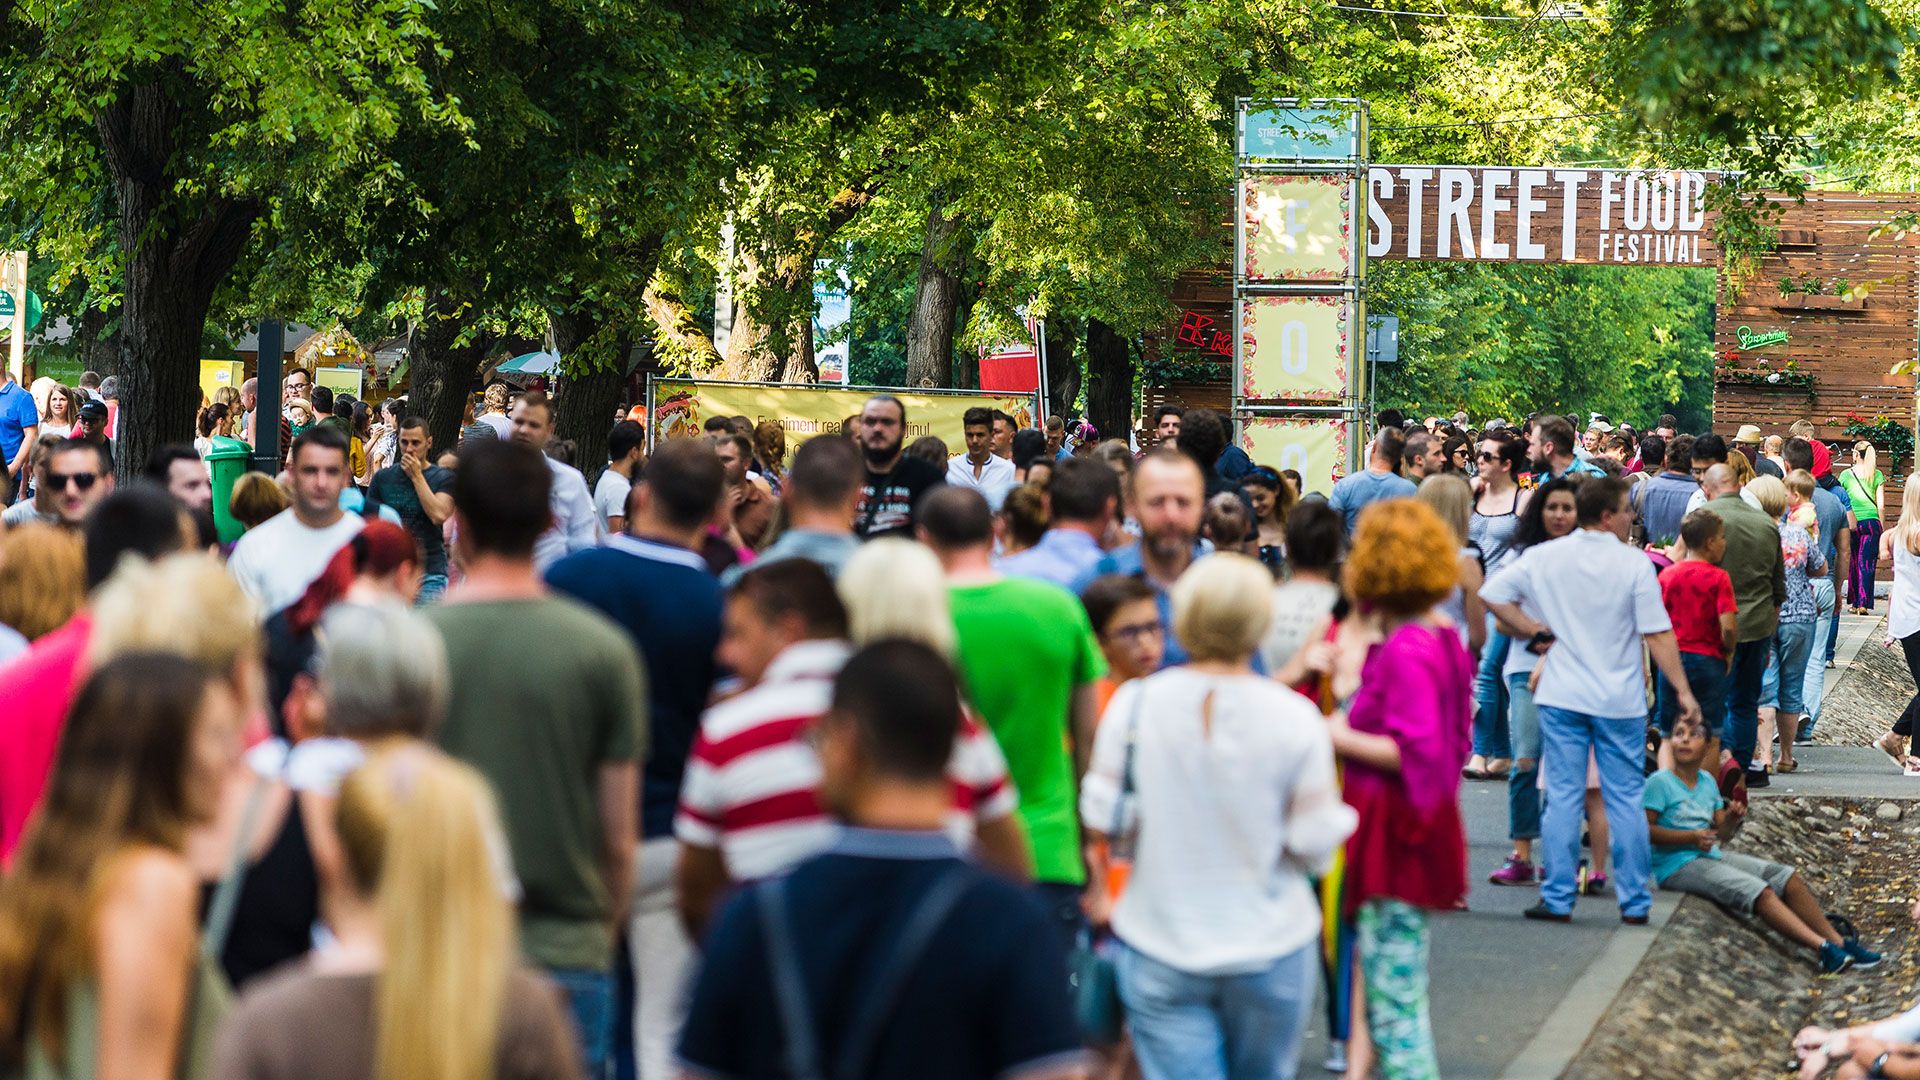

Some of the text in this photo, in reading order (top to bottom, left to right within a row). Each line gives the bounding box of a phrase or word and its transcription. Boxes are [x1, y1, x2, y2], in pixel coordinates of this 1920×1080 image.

[1367, 167, 1706, 262] STREET FOOD
[1599, 233, 1703, 264] FESTIVAL
